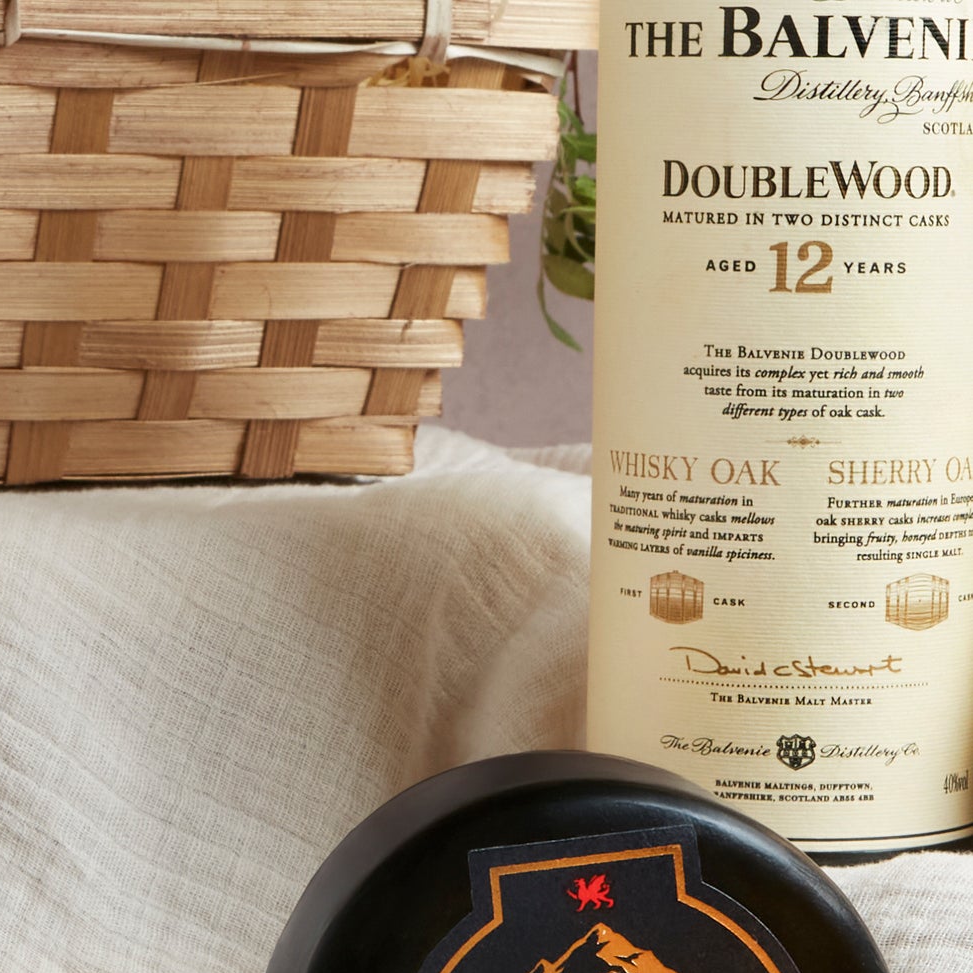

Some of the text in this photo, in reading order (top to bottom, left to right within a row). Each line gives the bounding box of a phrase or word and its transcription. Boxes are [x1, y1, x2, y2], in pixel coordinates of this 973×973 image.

[625, 6, 973, 61] THE BALVENI
[753, 69, 907, 124] Distillery,
[662, 211, 950, 227] MATURED IN TWO DISTINCT CASKS
[706, 240, 907, 293] AGED 12 YEARS
[683, 365, 924, 383] acquires its complex yet rich and smooth
[704, 383, 904, 399] taste from its maturation in two
[722, 402, 885, 421] different types of oak cask.
[610, 450, 781, 486] WHISKY OAK
[828, 459, 936, 485] SHERRY
[619, 485, 754, 507] Many years of maturation in
[827, 497, 883, 508] FURTHER
[887, 496, 938, 507] maturation
[940, 494, 948, 505] in
[609, 504, 775, 525] TRADITIONAL whisky casks mellows
[816, 514, 837, 526] oak
[841, 517, 885, 526] SHERRY
[888, 513, 914, 525] casks
[625, 524, 660, 539] maturing
[662, 527, 687, 540] spirit
[690, 528, 709, 540] and
[713, 532, 764, 542] IMPARTS
[814, 531, 863, 547] bringing
[865, 531, 898, 546] fruity,
[640, 543, 670, 554] LAYERS
[673, 544, 685, 555] of
[686, 546, 723, 558] vanilla
[726, 548, 775, 562] spiciness.
[857, 549, 903, 563] resulting
[906, 550, 939, 559] SINGLE
[620, 588, 642, 598] FIRST
[713, 598, 746, 606] CASK
[669, 646, 767, 675] David
[660, 735, 689, 750] The
[691, 737, 771, 756] Balvenie
[820, 744, 899, 766] Distillery
[716, 780, 761, 789] BALVENIE
[765, 781, 816, 791] MALTINGS,
[779, 794, 830, 803] SCOTLAND
